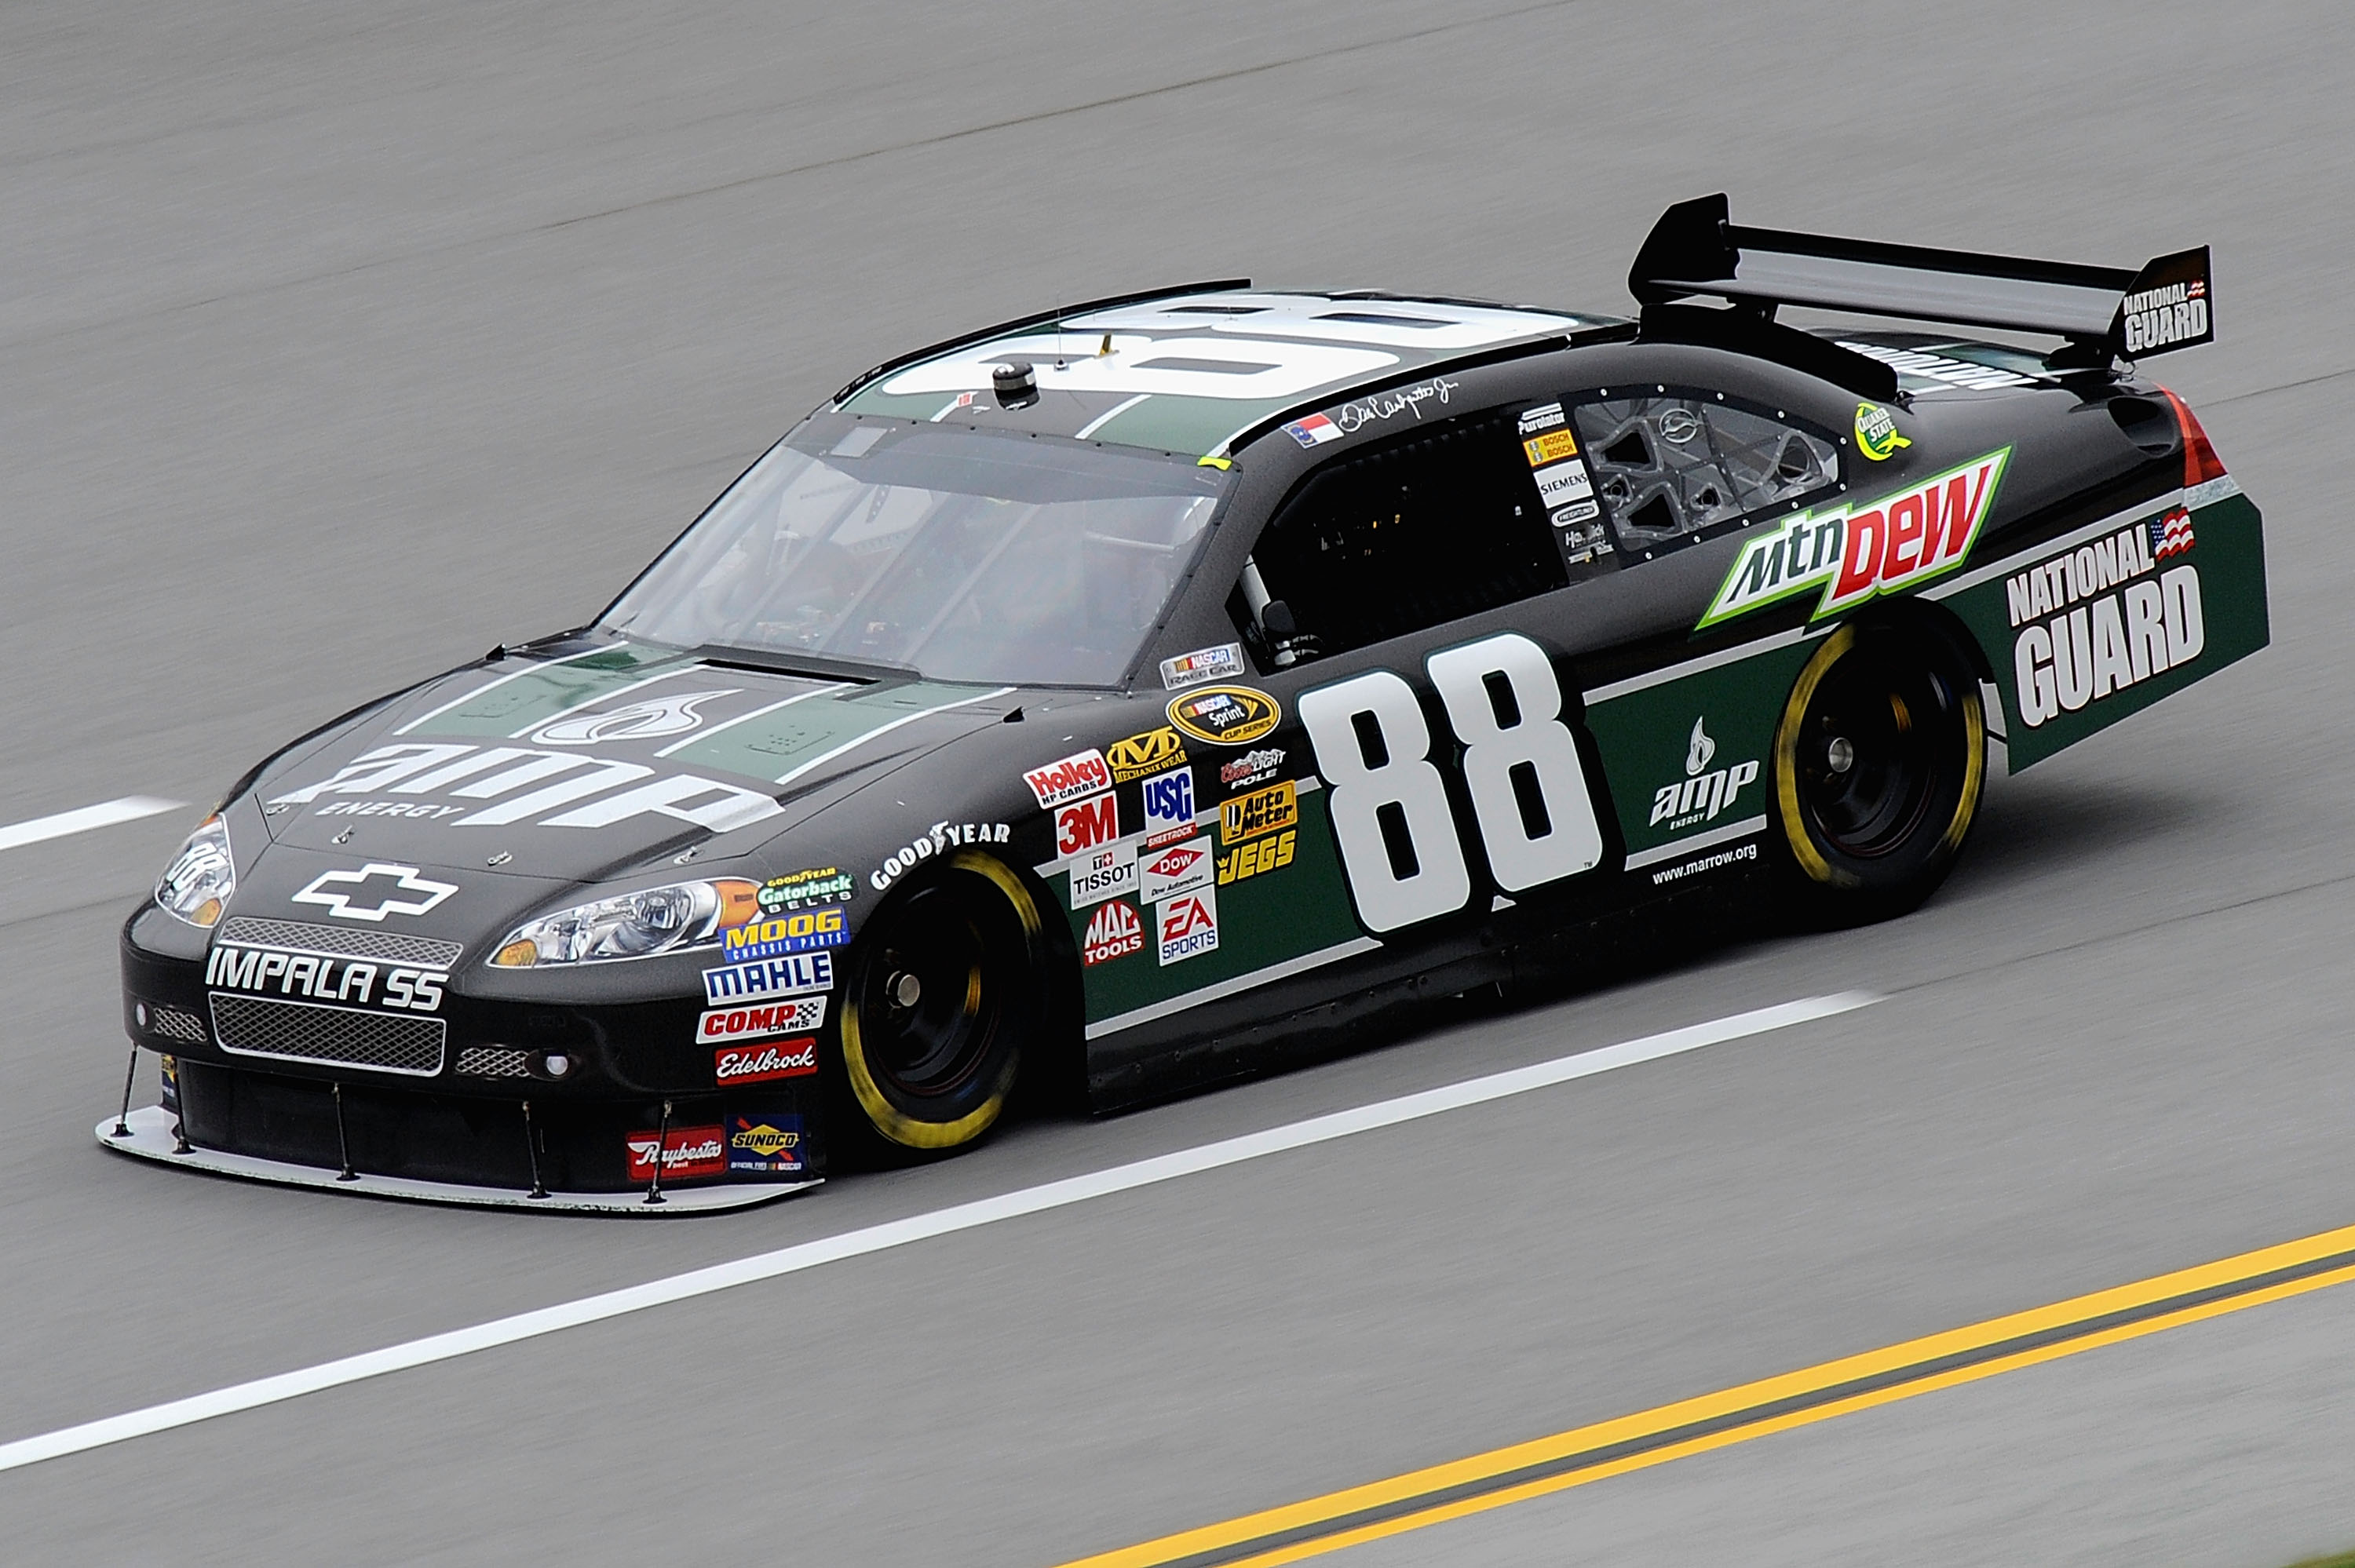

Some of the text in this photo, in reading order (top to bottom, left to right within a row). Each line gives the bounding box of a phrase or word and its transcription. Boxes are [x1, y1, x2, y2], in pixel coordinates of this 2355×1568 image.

[2123, 283, 2188, 315] NATIONAL
[2125, 299, 2207, 352] GUARD
[1517, 412, 1565, 435] Purolator
[1857, 407, 1890, 432] QUAKER
[1870, 418, 1896, 443] STATE
[1543, 433, 1569, 447] BOSCH
[1546, 444, 1573, 458] BOSCH
[1541, 472, 1588, 495] SIEMENS
[2007, 523, 2156, 628] NATIONAL
[1192, 649, 1230, 669] NASCAR
[2014, 563, 2205, 728] GUARD
[1210, 665, 1236, 676] CAR
[1195, 695, 1232, 715] NASCAR
[1209, 706, 1246, 728] Sprint
[1224, 720, 1271, 740] CUP SERIES
[1028, 757, 1108, 797] Holley
[1113, 750, 1187, 783] MECHANIX WEAR
[1231, 768, 1277, 789] POLE
[1145, 772, 1192, 822] USG
[1298, 633, 1603, 933] 88
[1649, 760, 1759, 827] amp
[315, 801, 466, 819] ENERGY
[1042, 793, 1058, 805] HP
[1244, 790, 1283, 815] Auto
[1059, 795, 1116, 855] 3M
[1236, 804, 1294, 836] Meter
[1670, 811, 1705, 830] ENERGY
[1148, 826, 1193, 847] SHEETROCK
[1218, 830, 1296, 886] JEGS
[1652, 844, 1757, 885] www.marrow.org
[758, 875, 853, 906] Gatorback
[767, 867, 836, 888] GOODYEAR
[1074, 862, 1135, 895] TISSOT
[1151, 888, 1165, 897] Dow
[1167, 875, 1203, 892] Automotive
[769, 891, 853, 914] BELTS
[726, 909, 842, 950] MOOG
[1085, 903, 1141, 950] MAC
[1163, 896, 1214, 943] EA
[733, 932, 842, 961] CHASSIS PARTS
[1085, 935, 1142, 964] TOOLS
[1163, 930, 1216, 960] SPORTS
[205, 946, 449, 1011] IMPALA SS
[706, 953, 831, 997] MAHLE
[704, 1004, 796, 1036] COMP
[767, 1019, 810, 1033] CAMS
[716, 1045, 815, 1078] Edelbrock
[734, 1134, 798, 1147] SUNOCO
